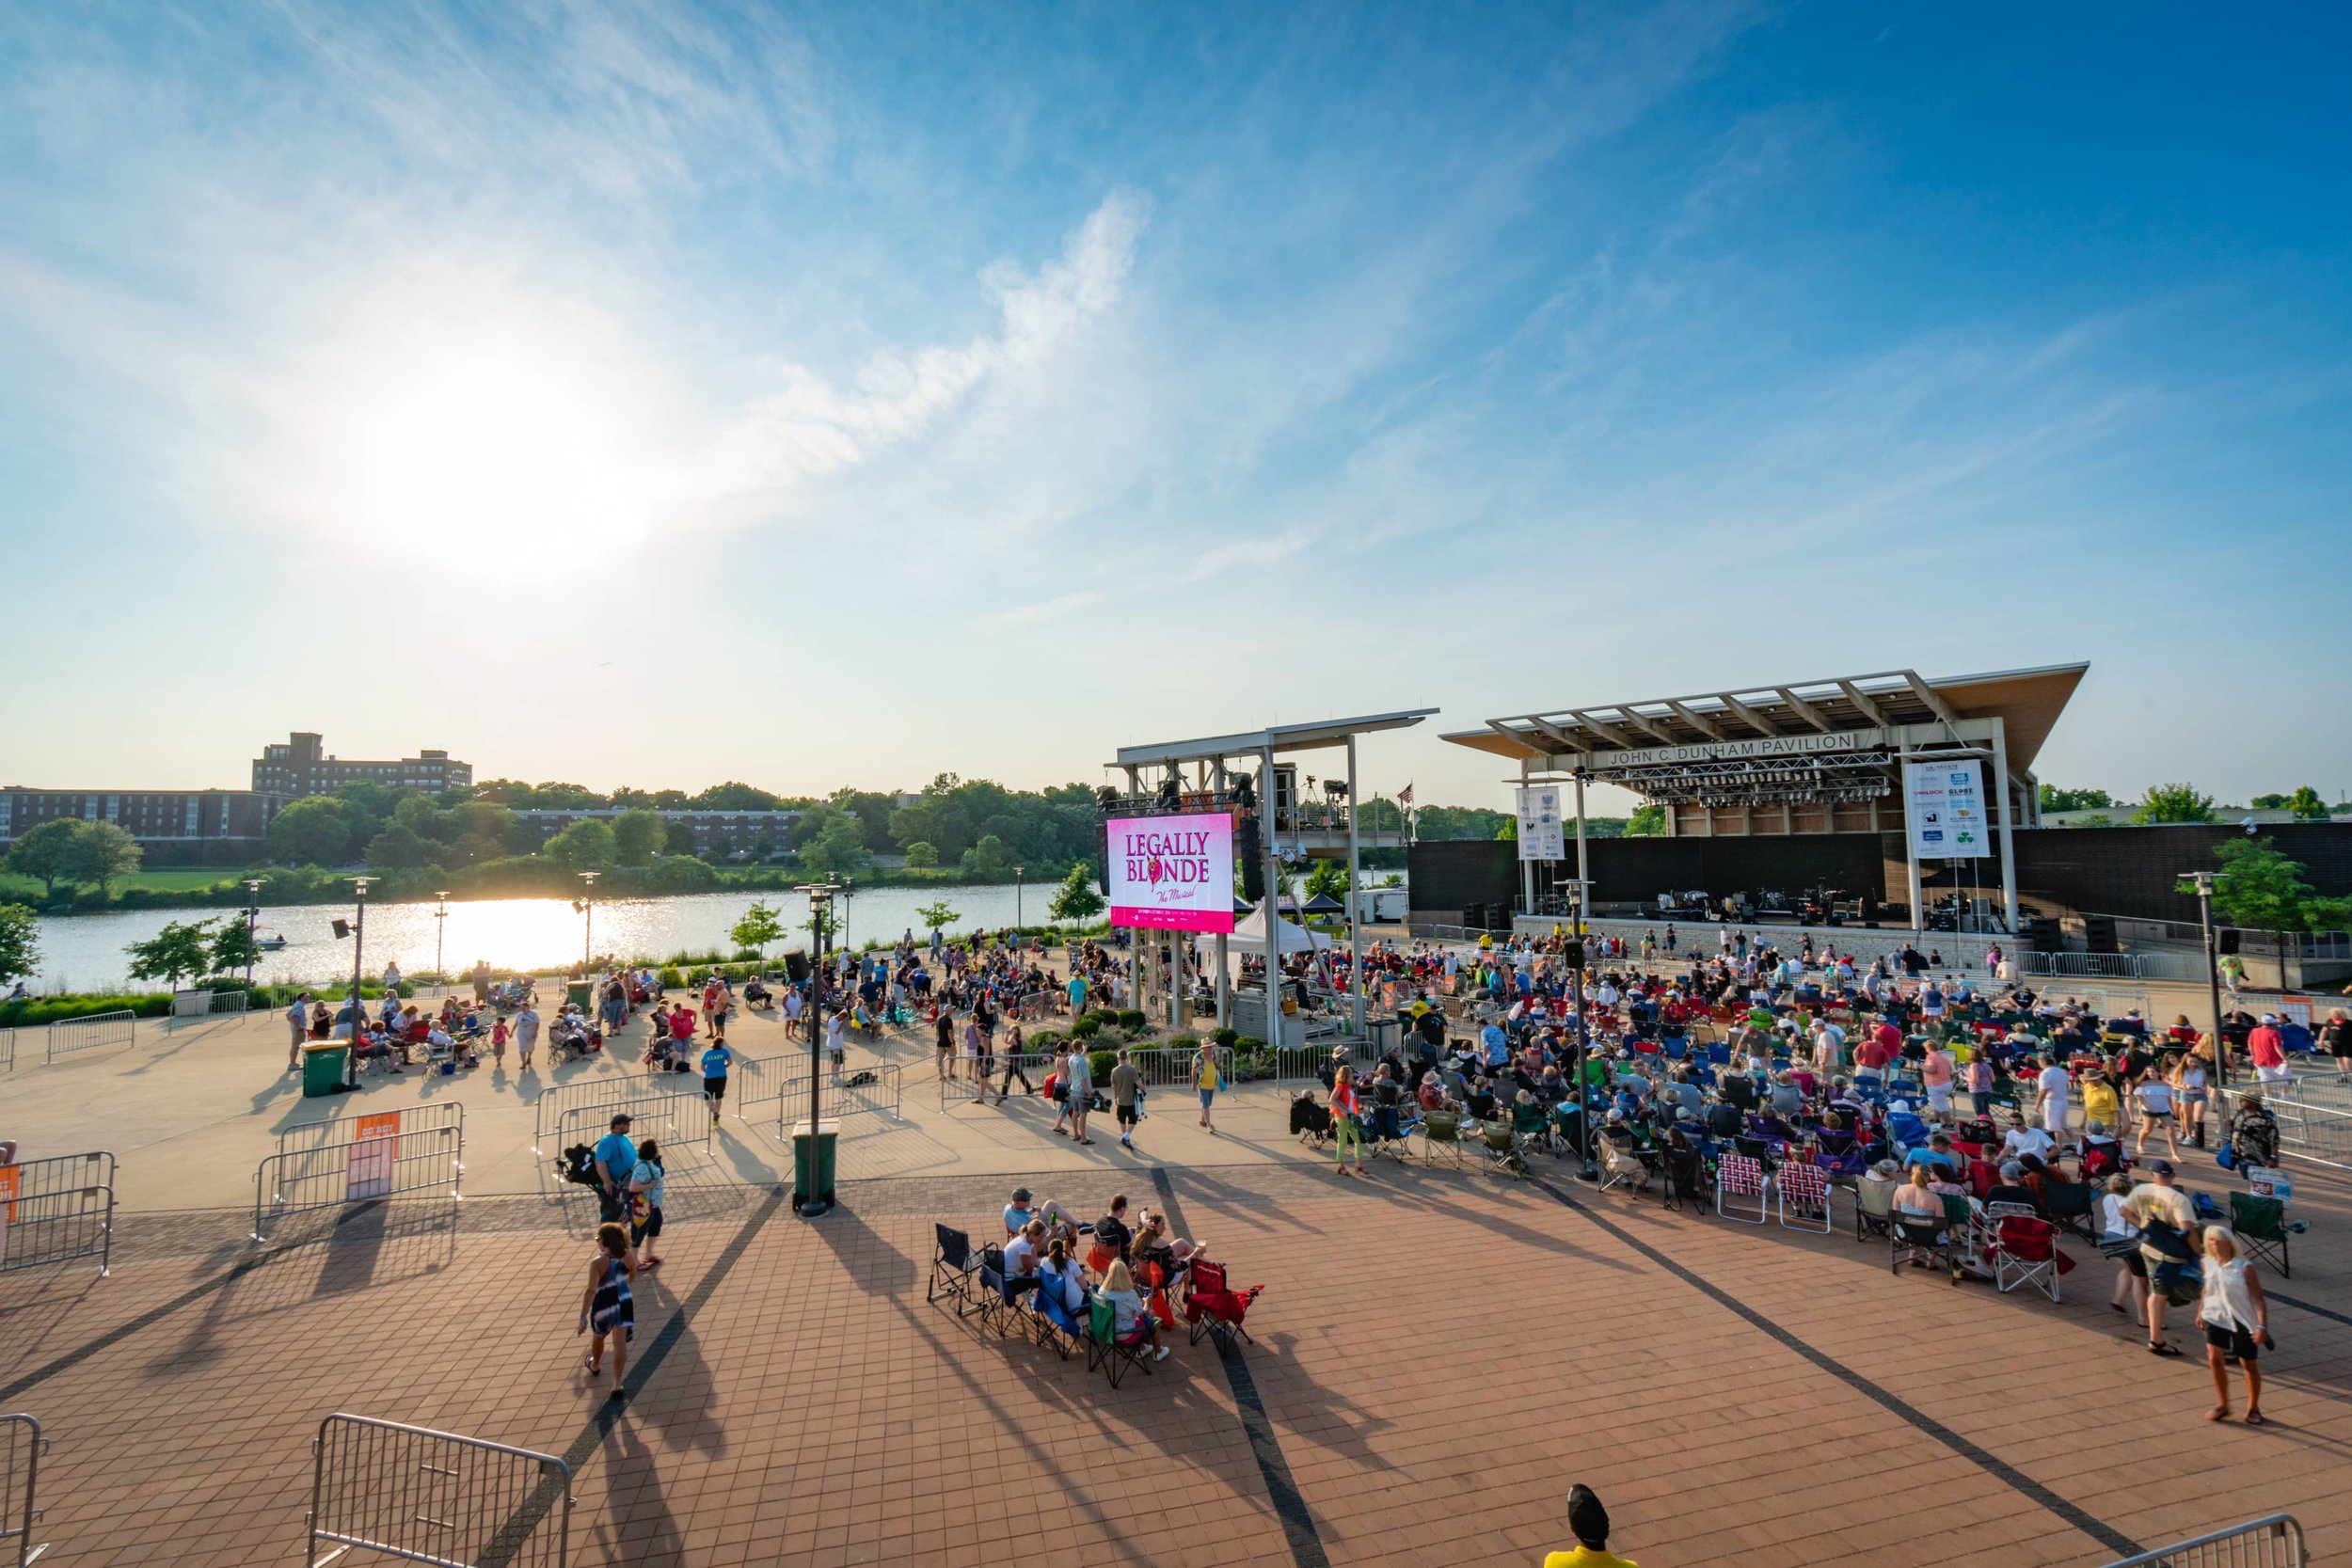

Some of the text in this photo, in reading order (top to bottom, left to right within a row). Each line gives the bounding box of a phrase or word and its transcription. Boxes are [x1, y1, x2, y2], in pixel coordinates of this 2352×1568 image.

[1611, 735, 1851, 765] JOHN C. DUNHAM PAVILION
[1126, 832, 1210, 856] LEGALLY
[1126, 859, 1209, 882] BLONDE
[1156, 884, 1197, 903] The Musical
